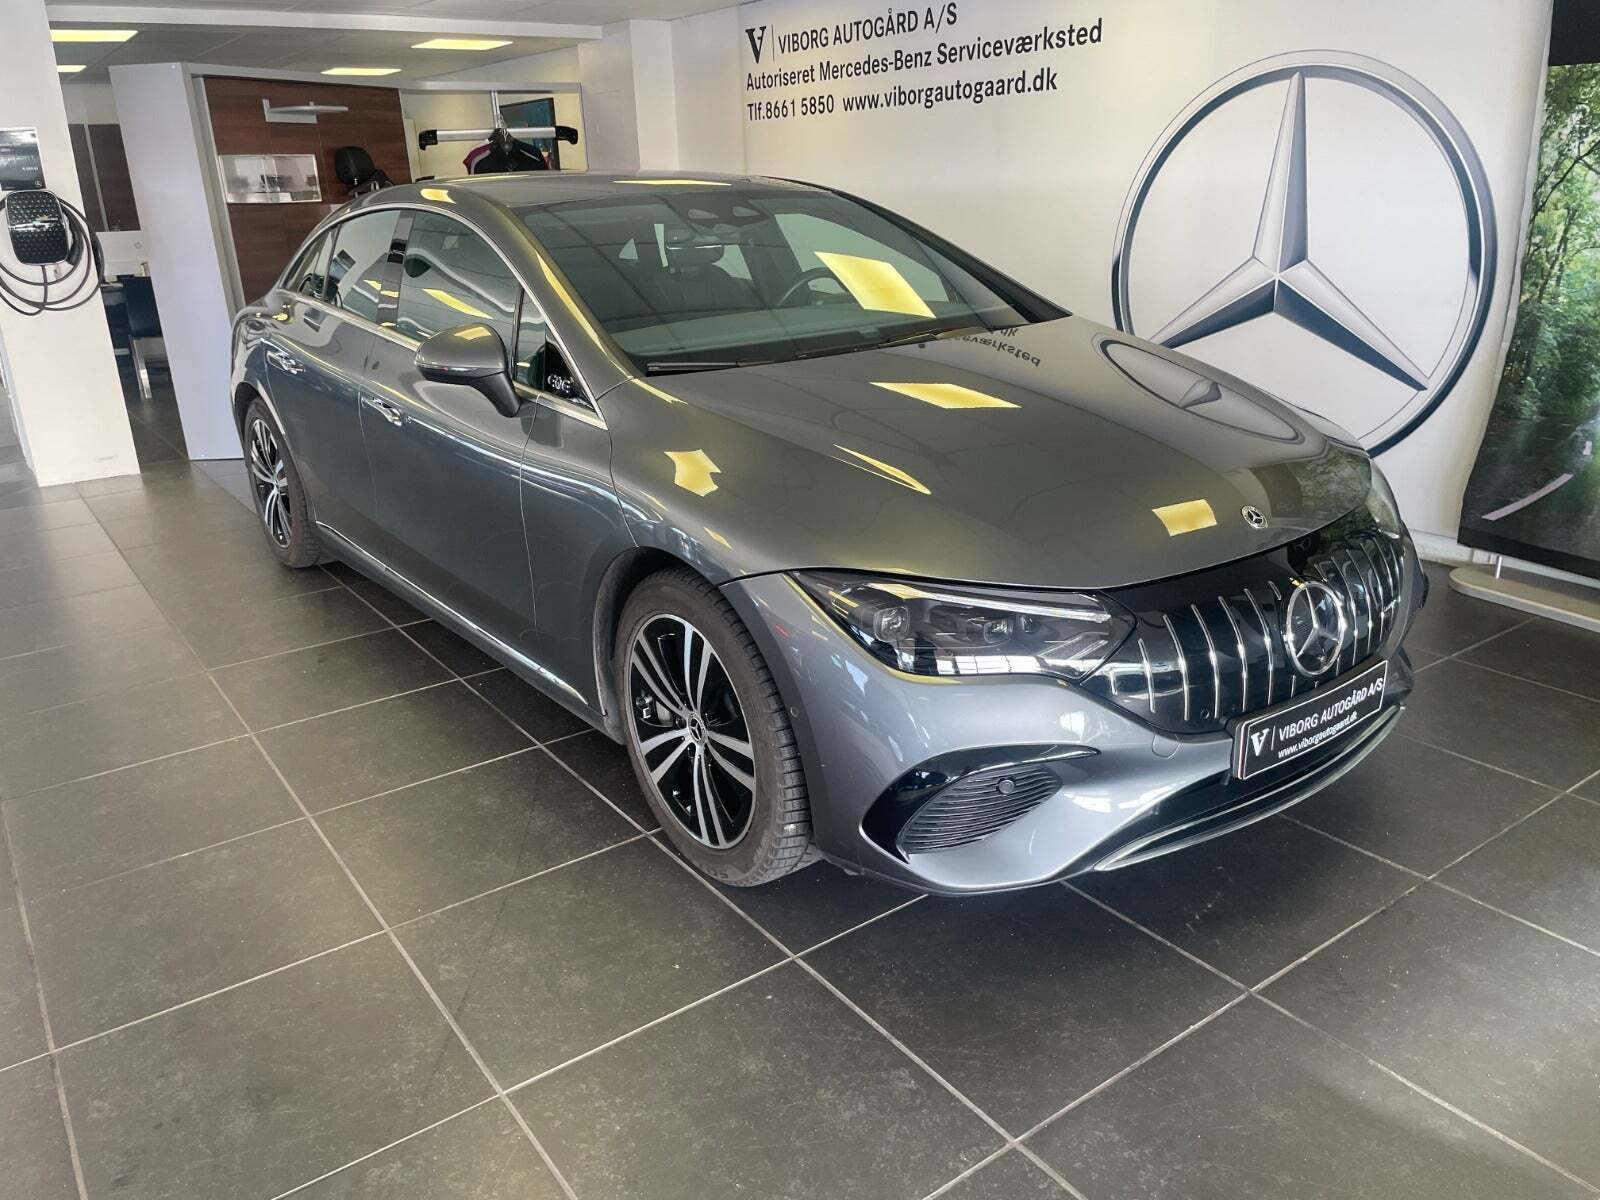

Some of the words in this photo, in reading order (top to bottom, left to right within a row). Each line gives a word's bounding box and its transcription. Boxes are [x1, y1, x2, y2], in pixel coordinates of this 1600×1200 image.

[746, 64, 815, 91] Autoriseret
[819, 50, 932, 81] Mercedes-Benz
[937, 18, 1102, 65] Serviceværksted
[778, 27, 829, 54] VIBORG
[833, 8, 919, 46] AUTOGÅRD
[924, 3, 958, 34] A/S
[801, 94, 835, 115] 5850
[842, 67, 1058, 113] www.viborgautogaard.dk
[1278, 713, 1319, 742] VIBORG
[1320, 687, 1367, 724] AUTOGÅRD
[1367, 677, 1384, 697] A/S
